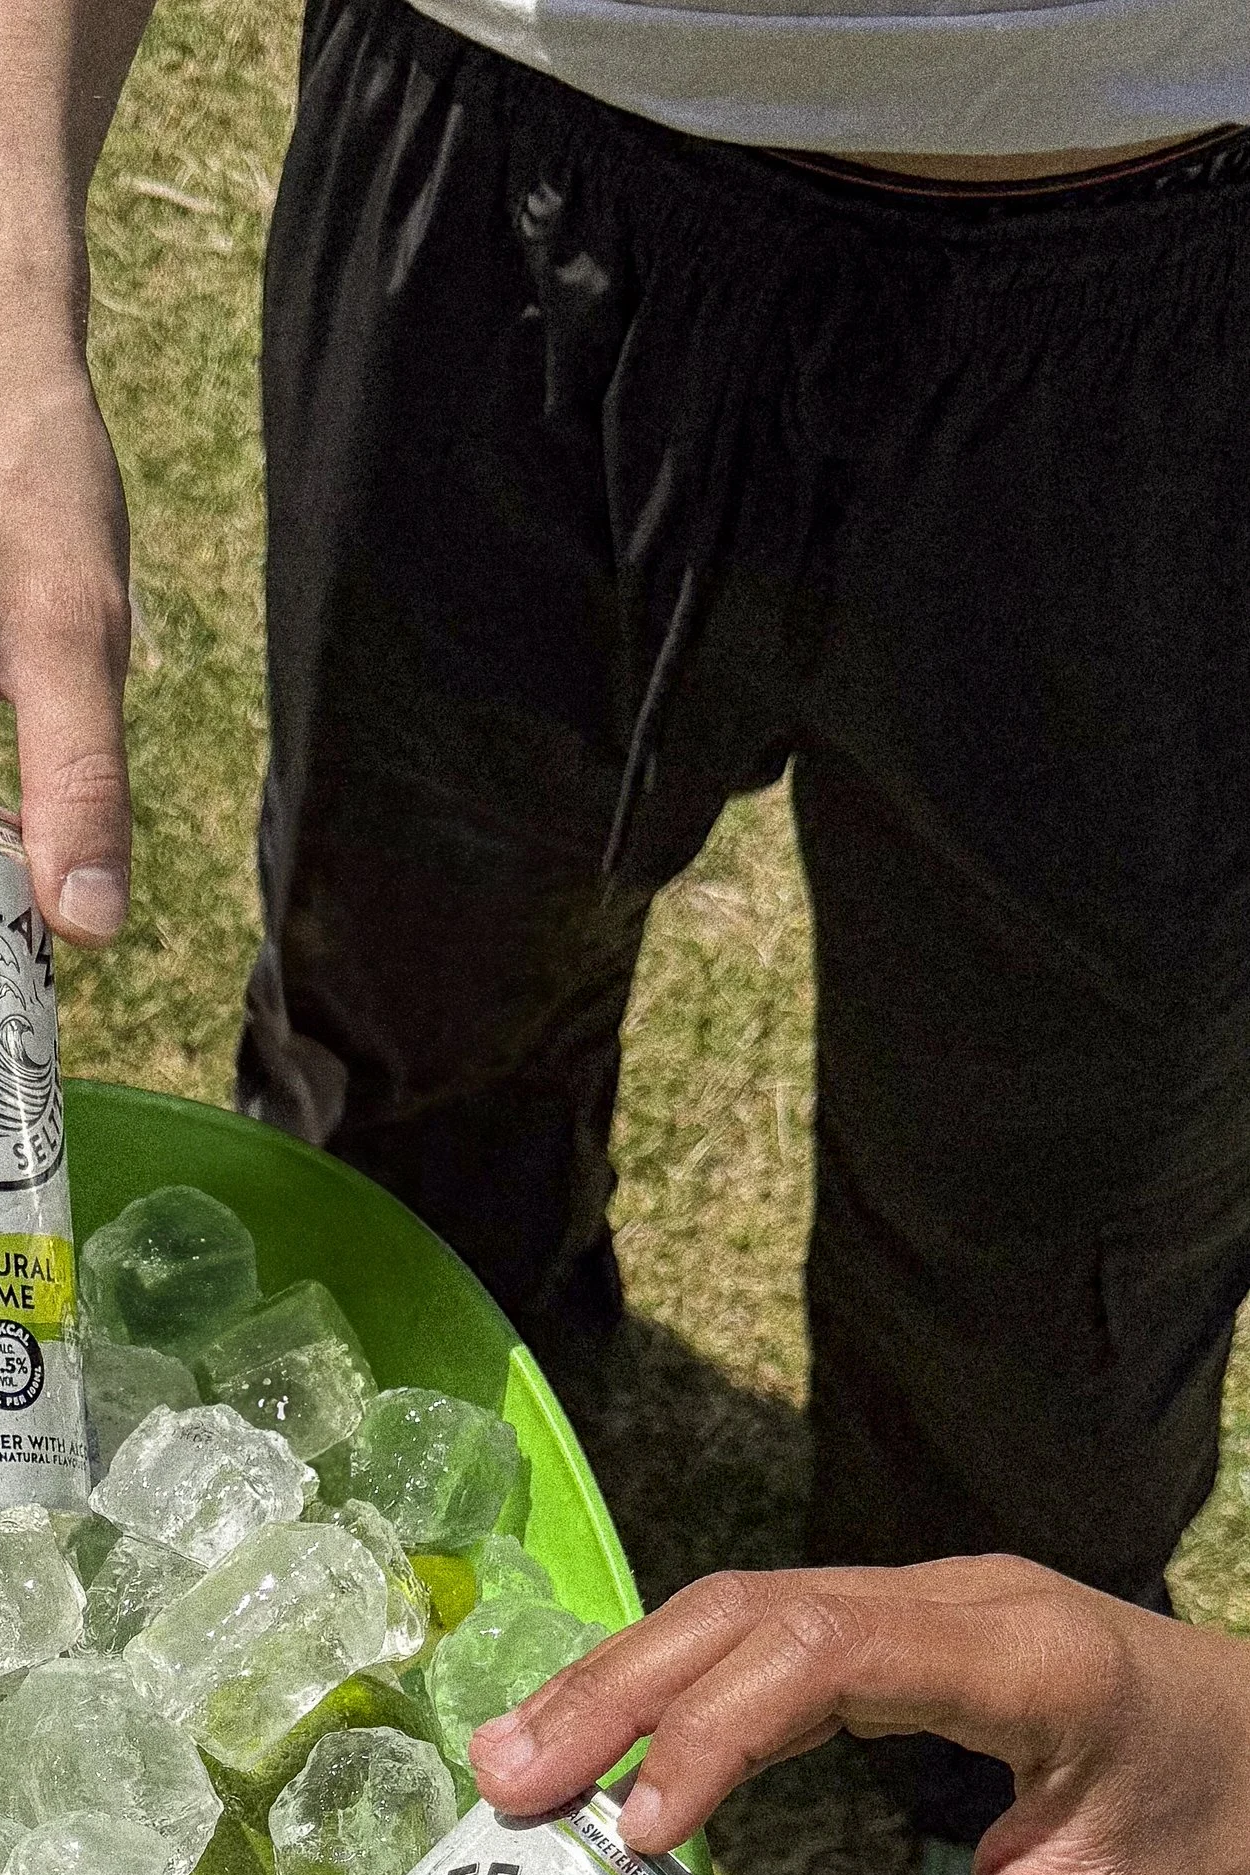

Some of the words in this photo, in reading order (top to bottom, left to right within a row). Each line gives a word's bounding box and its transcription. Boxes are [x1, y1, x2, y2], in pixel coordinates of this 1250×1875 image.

[6, 1394, 28, 1407] PER
[27, 1434, 66, 1454] WITH
[0, 1452, 51, 1465] NATURAL
